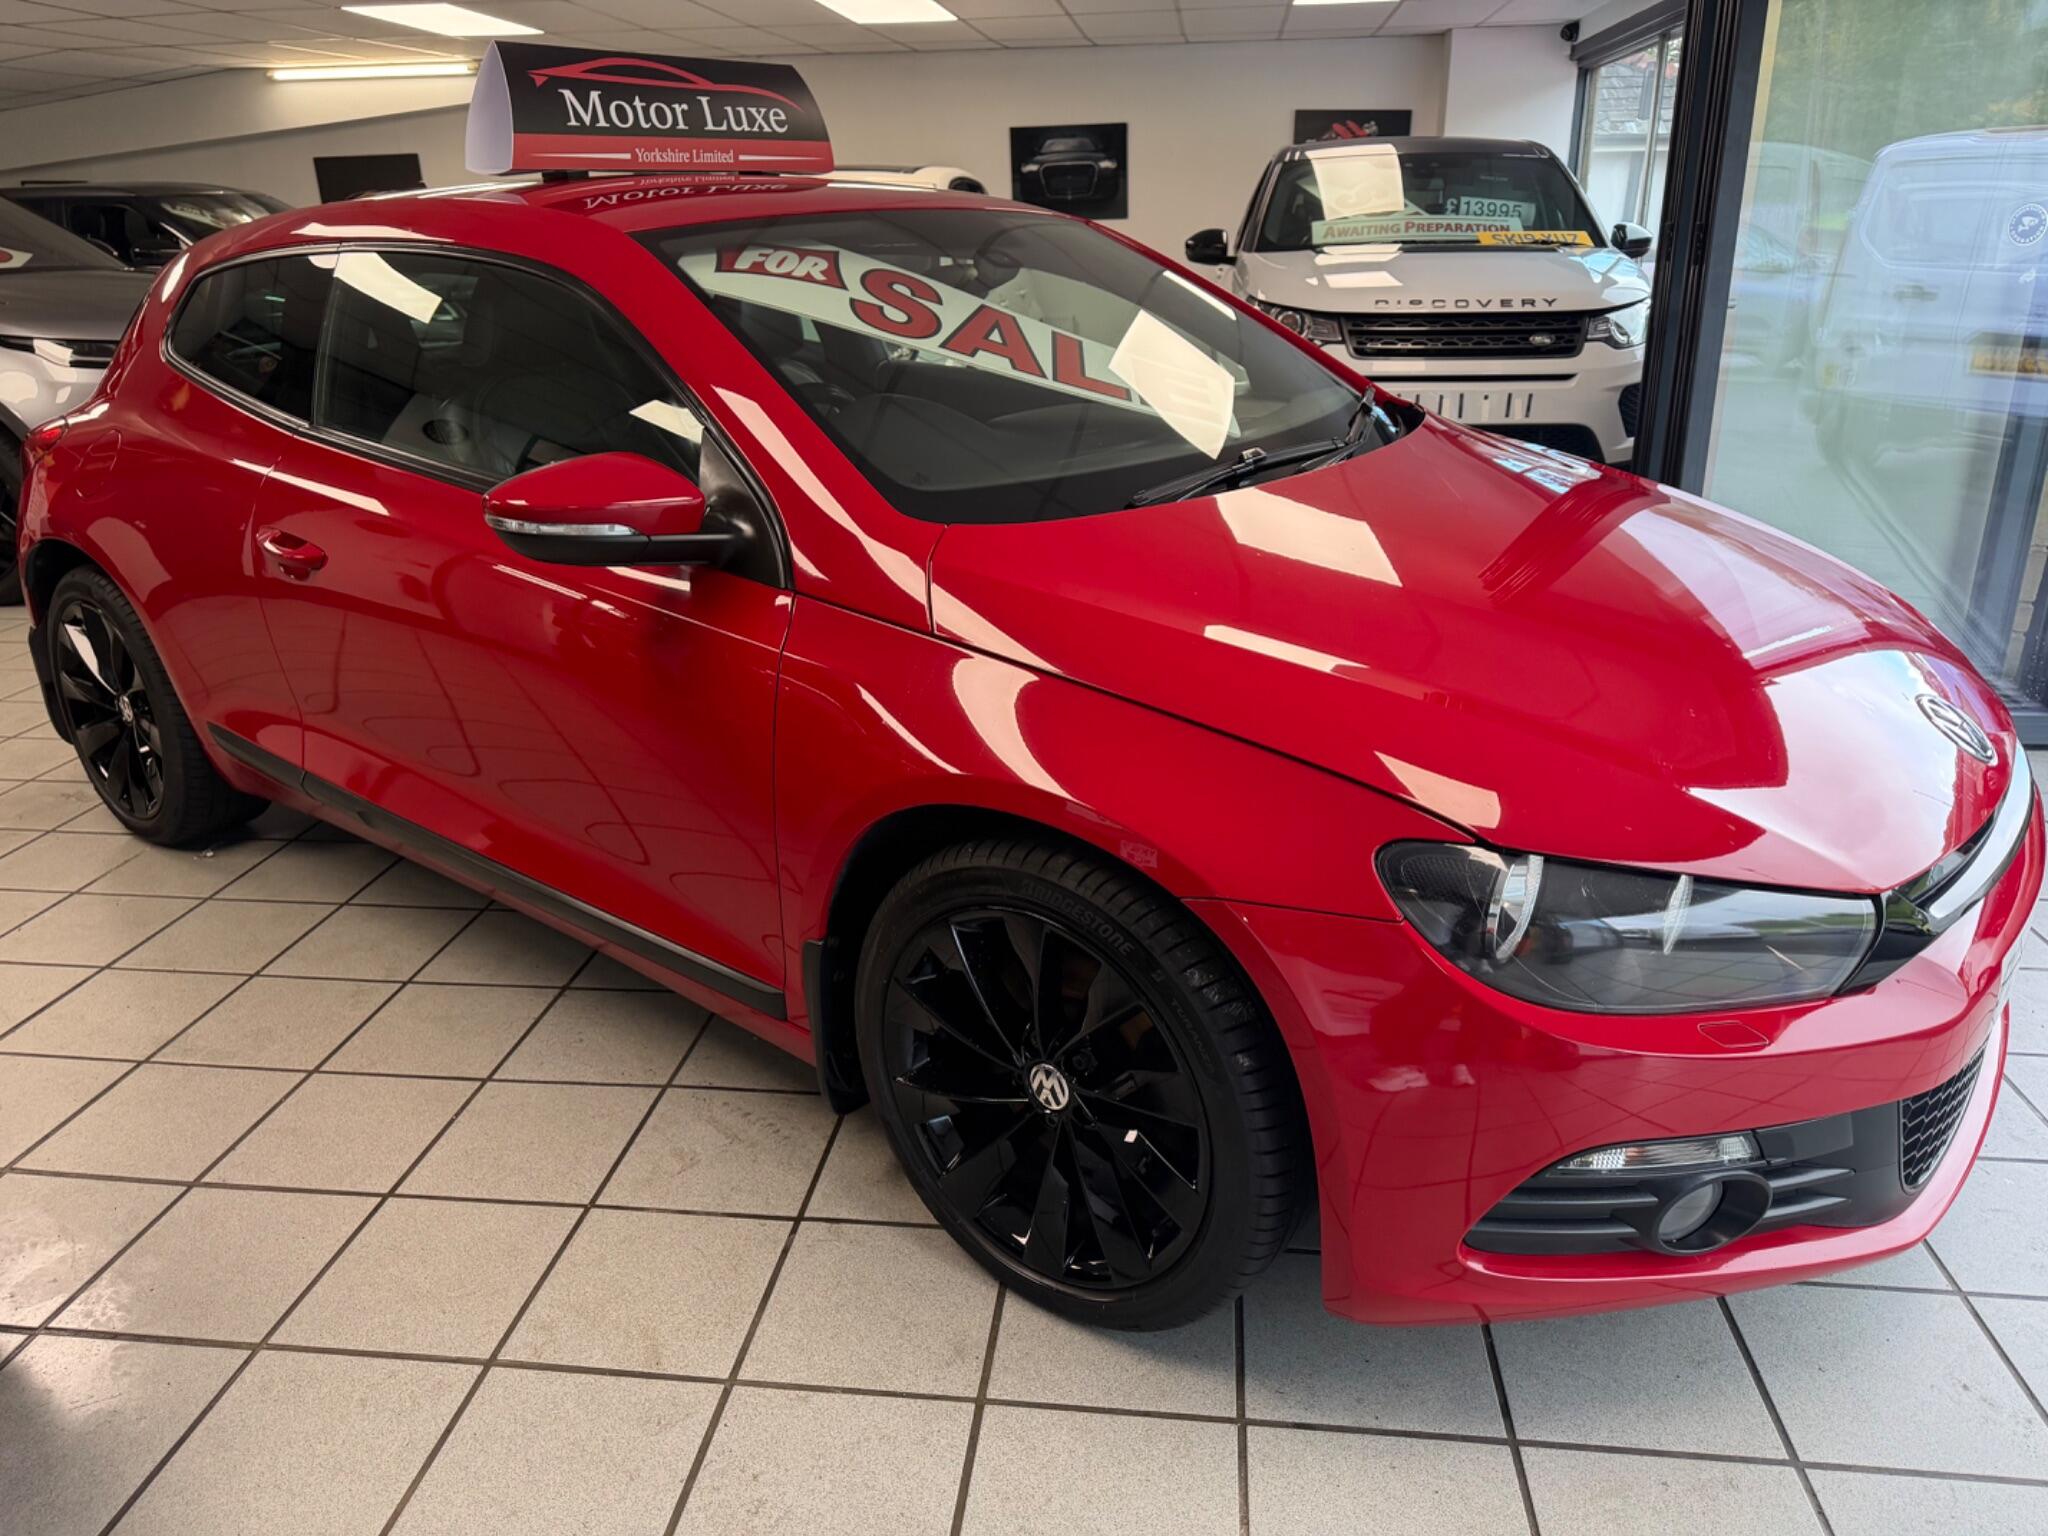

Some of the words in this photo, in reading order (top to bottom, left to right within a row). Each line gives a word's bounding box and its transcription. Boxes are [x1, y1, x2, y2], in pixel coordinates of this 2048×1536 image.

[557, 88, 689, 129] Motor
[697, 95, 789, 133] Luxe
[634, 147, 690, 163] Yorkshire
[692, 148, 734, 163] Limited
[733, 246, 829, 281] FOR
[849, 268, 1150, 407] SAL
[1021, 878, 1136, 957] BRIDGESTONE
